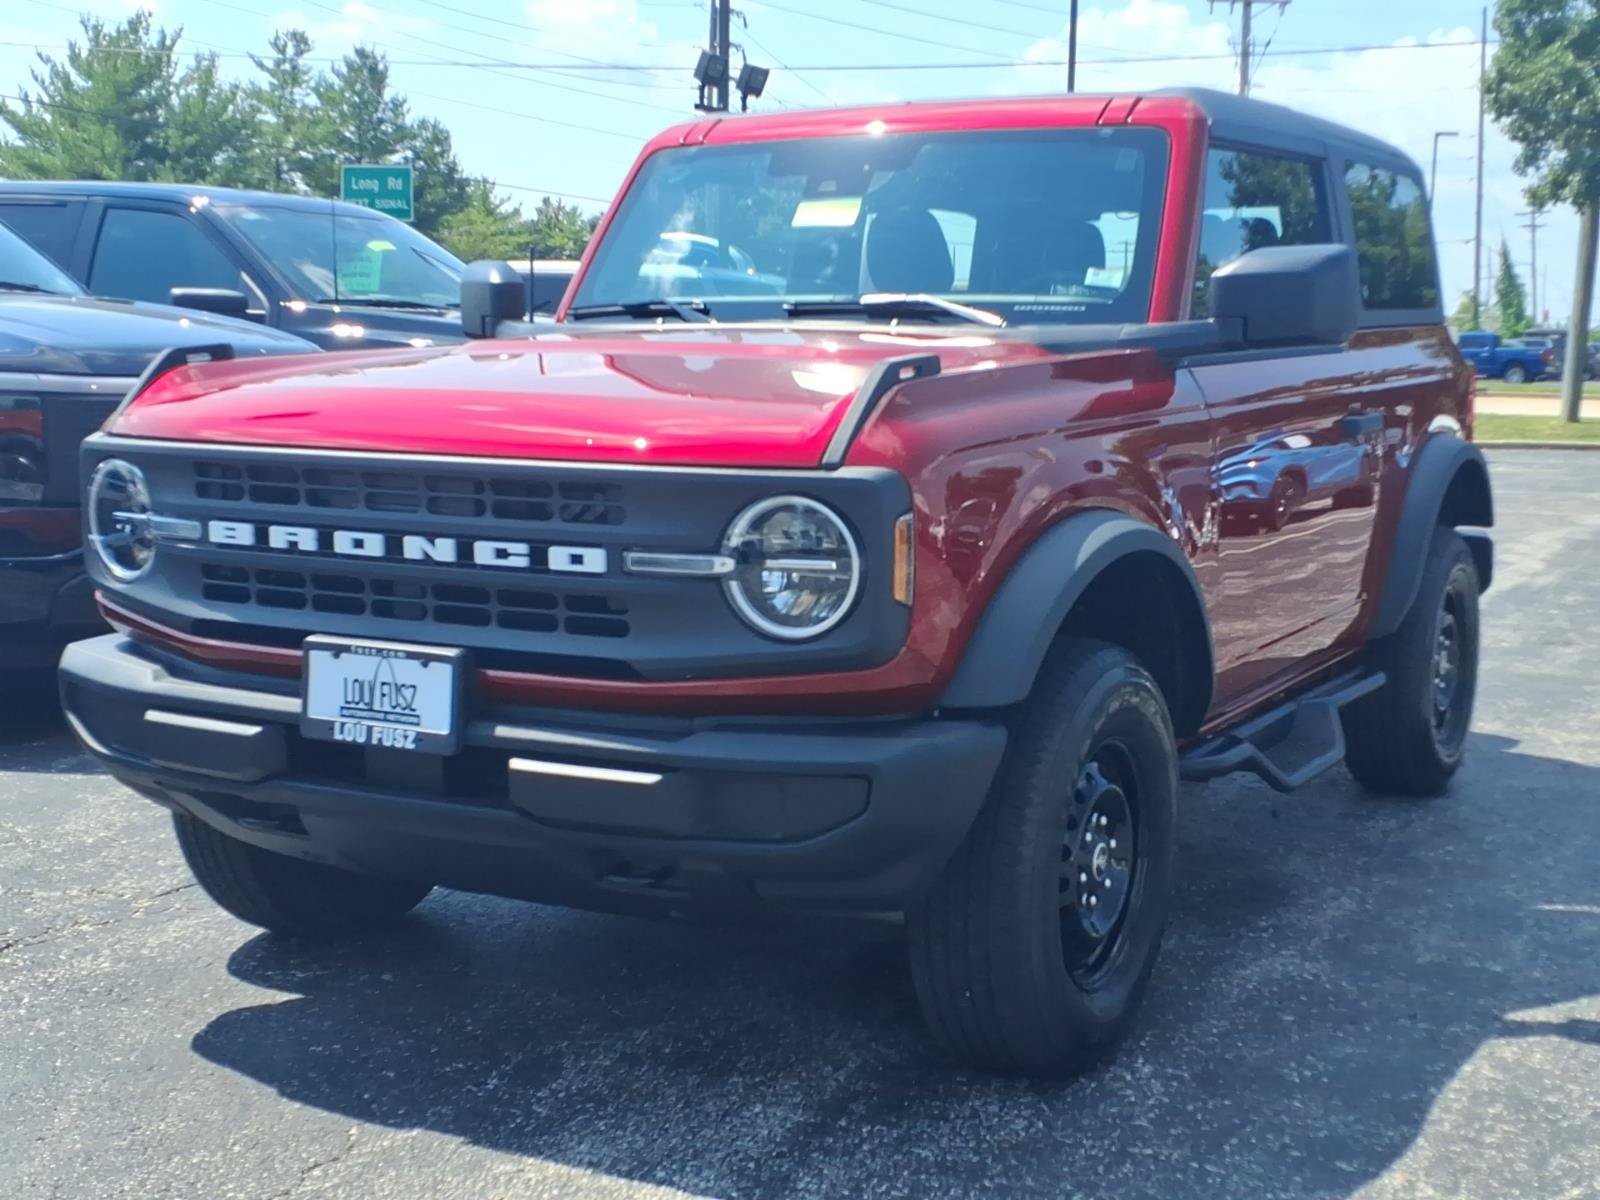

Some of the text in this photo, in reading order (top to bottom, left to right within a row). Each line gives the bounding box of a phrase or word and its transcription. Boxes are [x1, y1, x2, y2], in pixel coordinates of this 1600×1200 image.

[351, 176, 402, 193] Long Rd
[374, 199, 409, 210] SIGNAL
[208, 520, 607, 574] BRONCO
[343, 677, 417, 712] LOU FUSZ
[333, 722, 417, 749] LOU FUSZ
